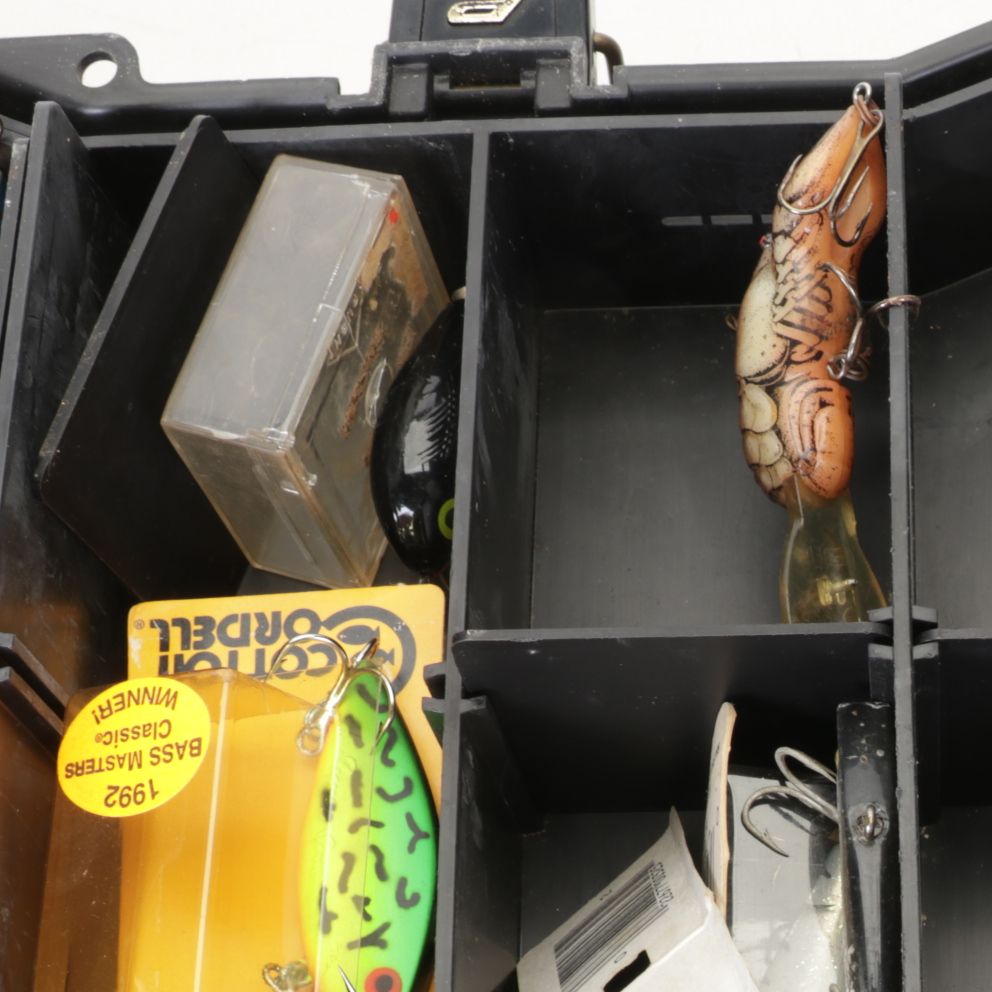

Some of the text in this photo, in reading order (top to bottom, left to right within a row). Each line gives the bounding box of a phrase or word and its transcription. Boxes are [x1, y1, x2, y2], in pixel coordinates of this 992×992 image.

[91, 685, 179, 726] WINNER!
[64, 736, 203, 780] BASS MASTERS
[103, 777, 159, 809] 1992
